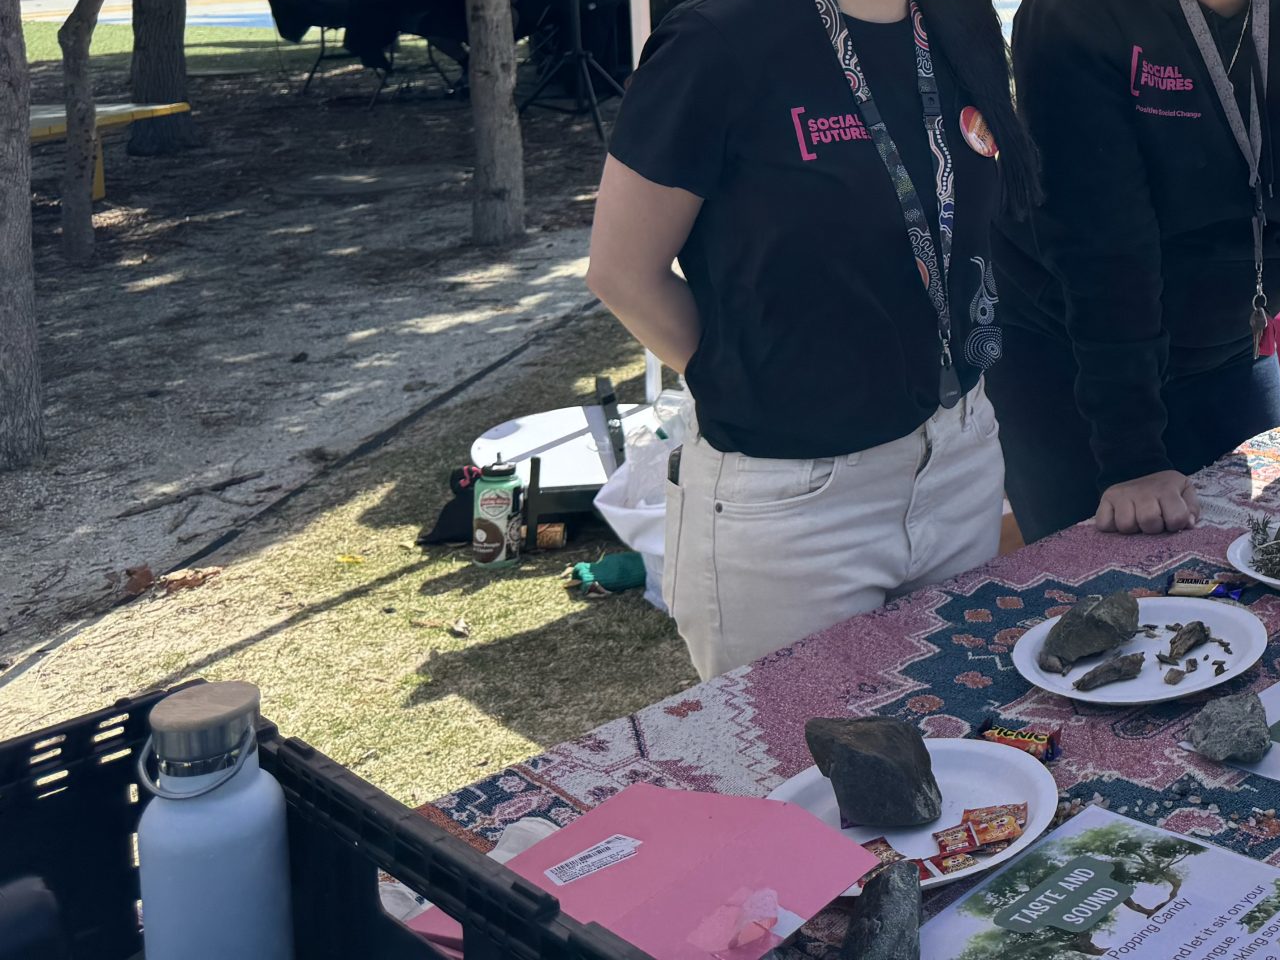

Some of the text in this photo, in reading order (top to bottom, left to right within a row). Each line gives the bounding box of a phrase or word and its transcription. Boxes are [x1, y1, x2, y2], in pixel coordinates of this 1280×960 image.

[1142, 60, 1182, 78] SOCIAL
[1141, 72, 1194, 91] FUTURES
[808, 114, 864, 132] SOCIAL
[1159, 109, 1176, 117] Social
[1176, 110, 1202, 119] Change
[810, 126, 872, 145] FUTURE
[1009, 868, 1095, 924] TASTE AND
[1062, 887, 1119, 925] SOUND
[1189, 934, 1208, 950] let
[1200, 927, 1217, 937] it
[1212, 914, 1232, 928] sit
[1227, 903, 1246, 916] on
[1240, 884, 1266, 905] your
[1107, 897, 1192, 960] Popping Candy
